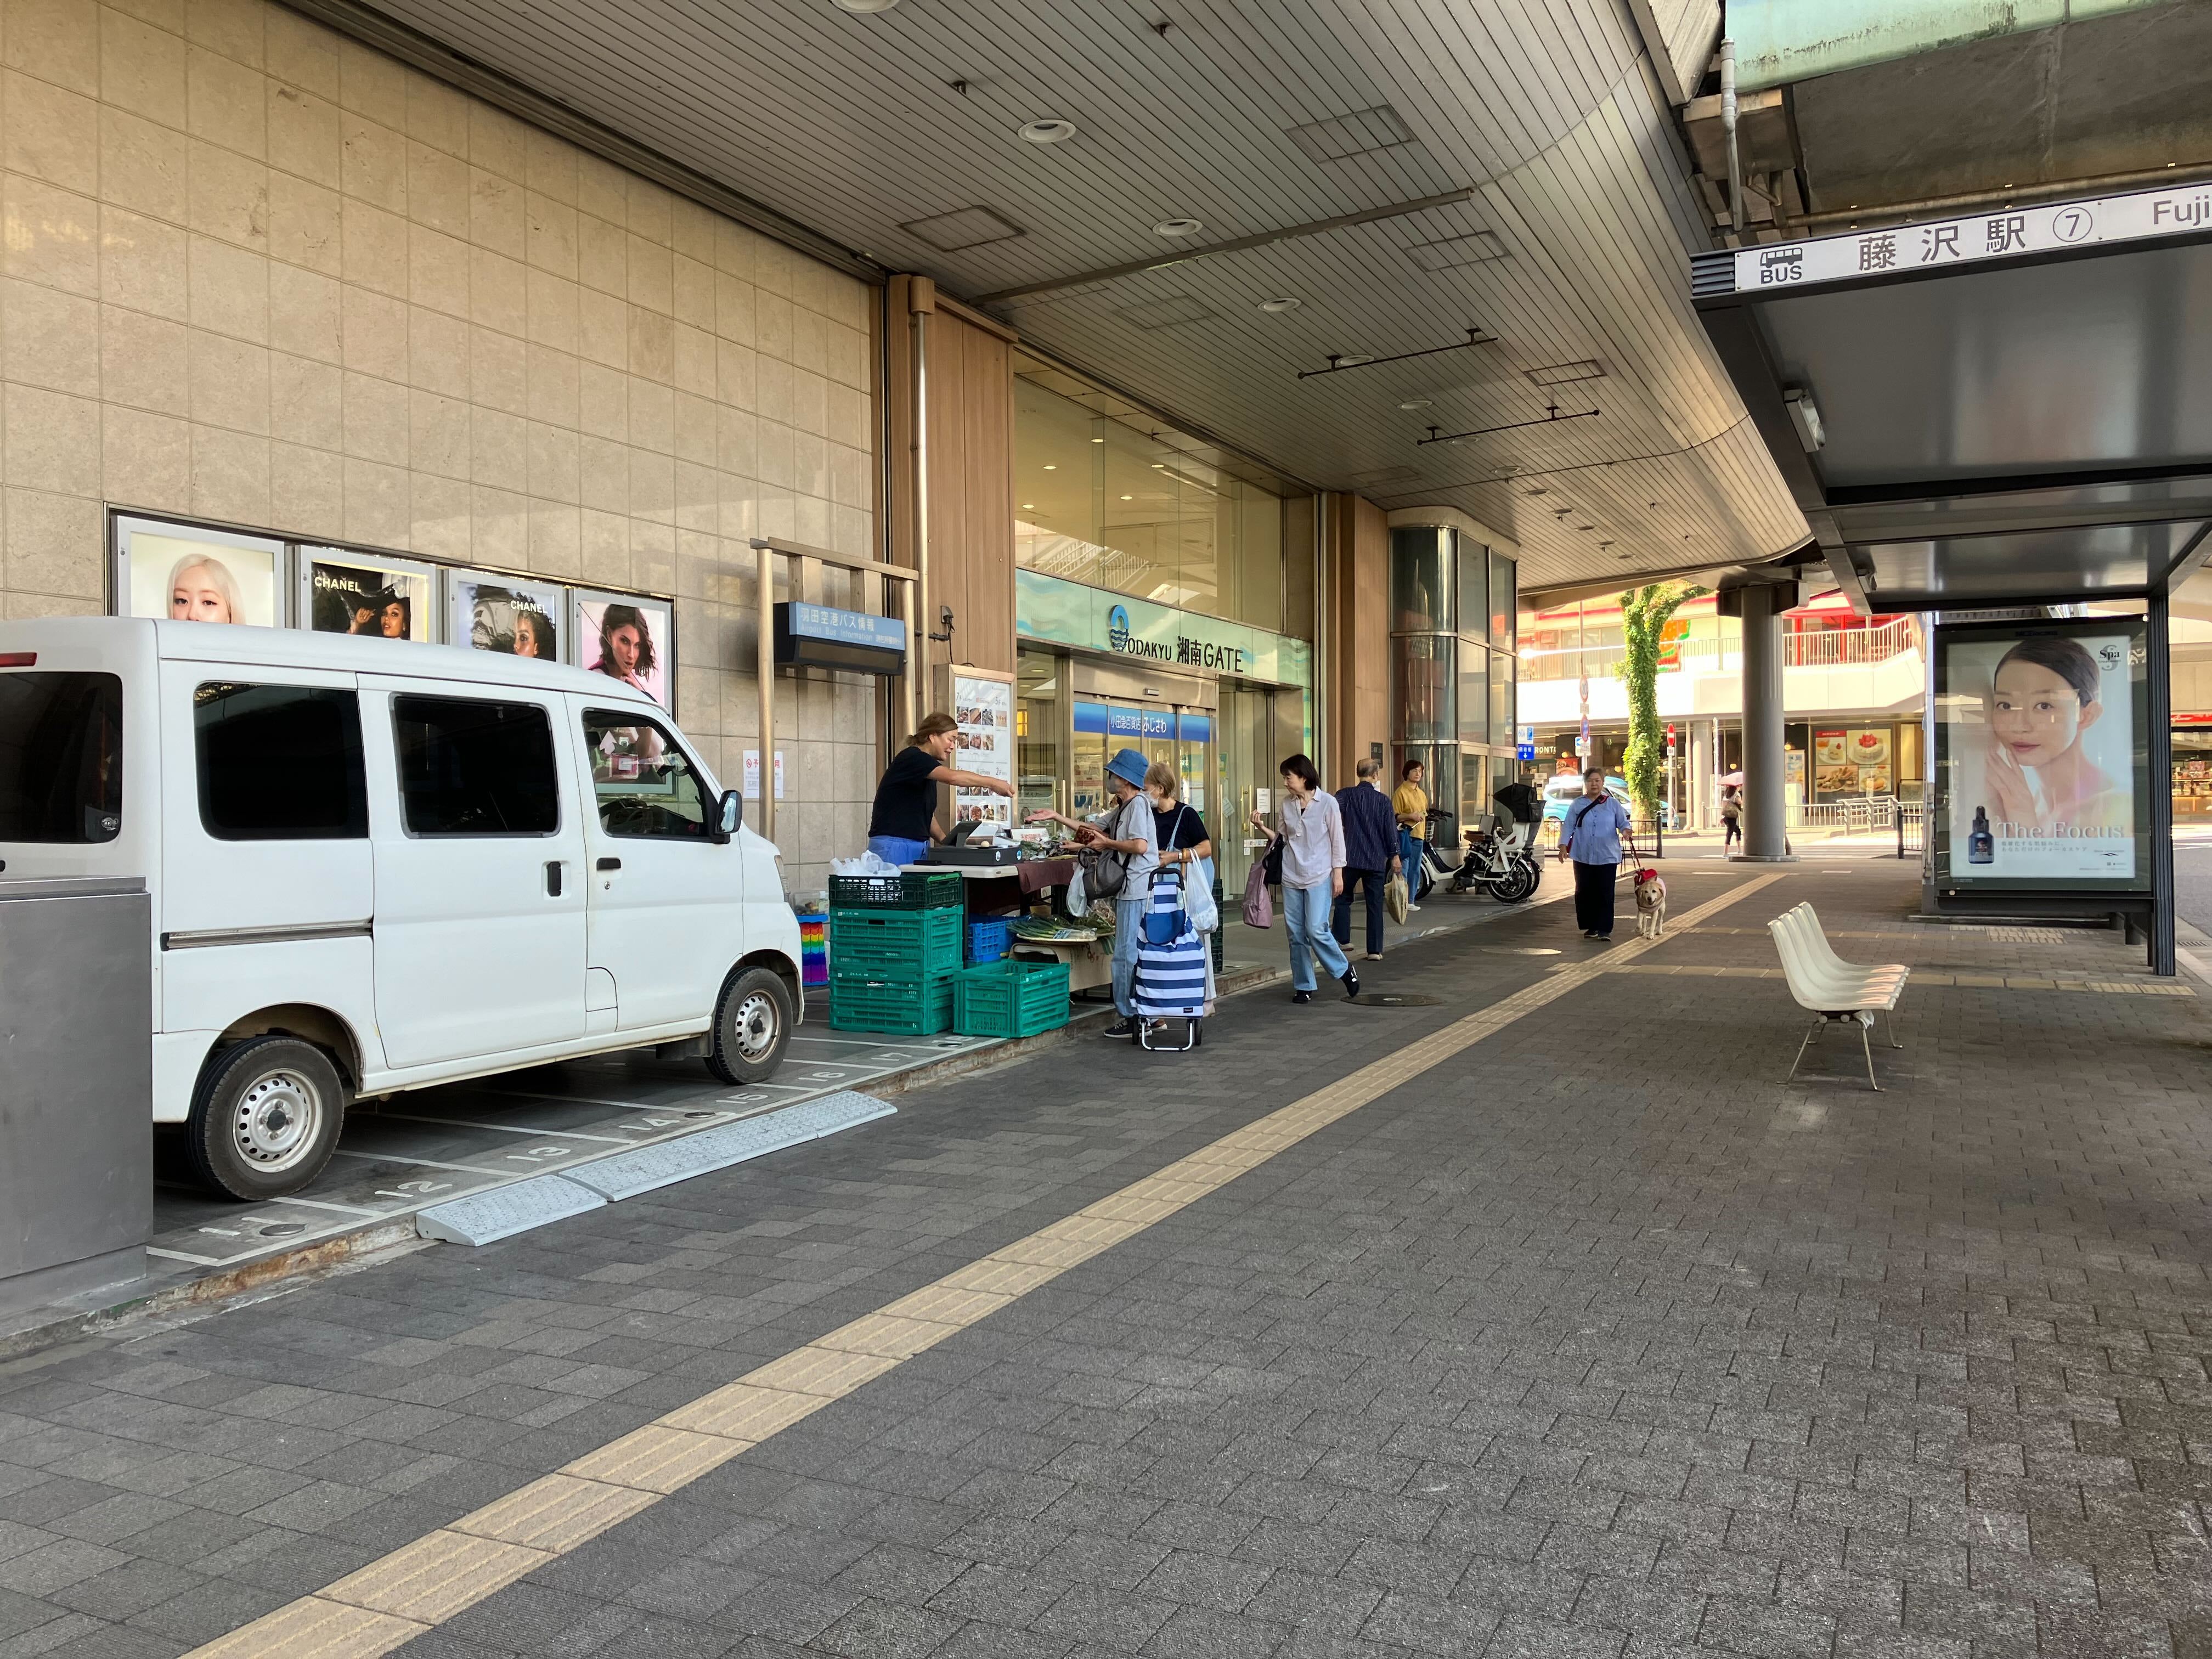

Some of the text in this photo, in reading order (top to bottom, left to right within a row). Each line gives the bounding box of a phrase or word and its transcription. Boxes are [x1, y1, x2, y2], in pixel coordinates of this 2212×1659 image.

[1858, 216, 2025, 271] 藤沢駅
[2153, 195, 2209, 226] Fuji
[1760, 264, 1802, 284] BUS
[314, 577, 362, 592] CHANEL
[510, 600, 548, 614] CHANEL
[800, 607, 875, 631] 羽田空港バス情報
[825, 628, 837, 636] Bus
[840, 630, 872, 641] Information
[1128, 637, 1172, 661] ODAKYU
[1111, 714, 1167, 733] 小田急百貨店 ふじさわ
[1996, 822, 2124, 838] The Focus
[871, 1052, 912, 1062] 17
[798, 1071, 846, 1082] 16
[715, 1093, 768, 1104] 15
[619, 1116, 680, 1131] 14
[506, 1147, 572, 1162] 13
[375, 1181, 453, 1198] 12
